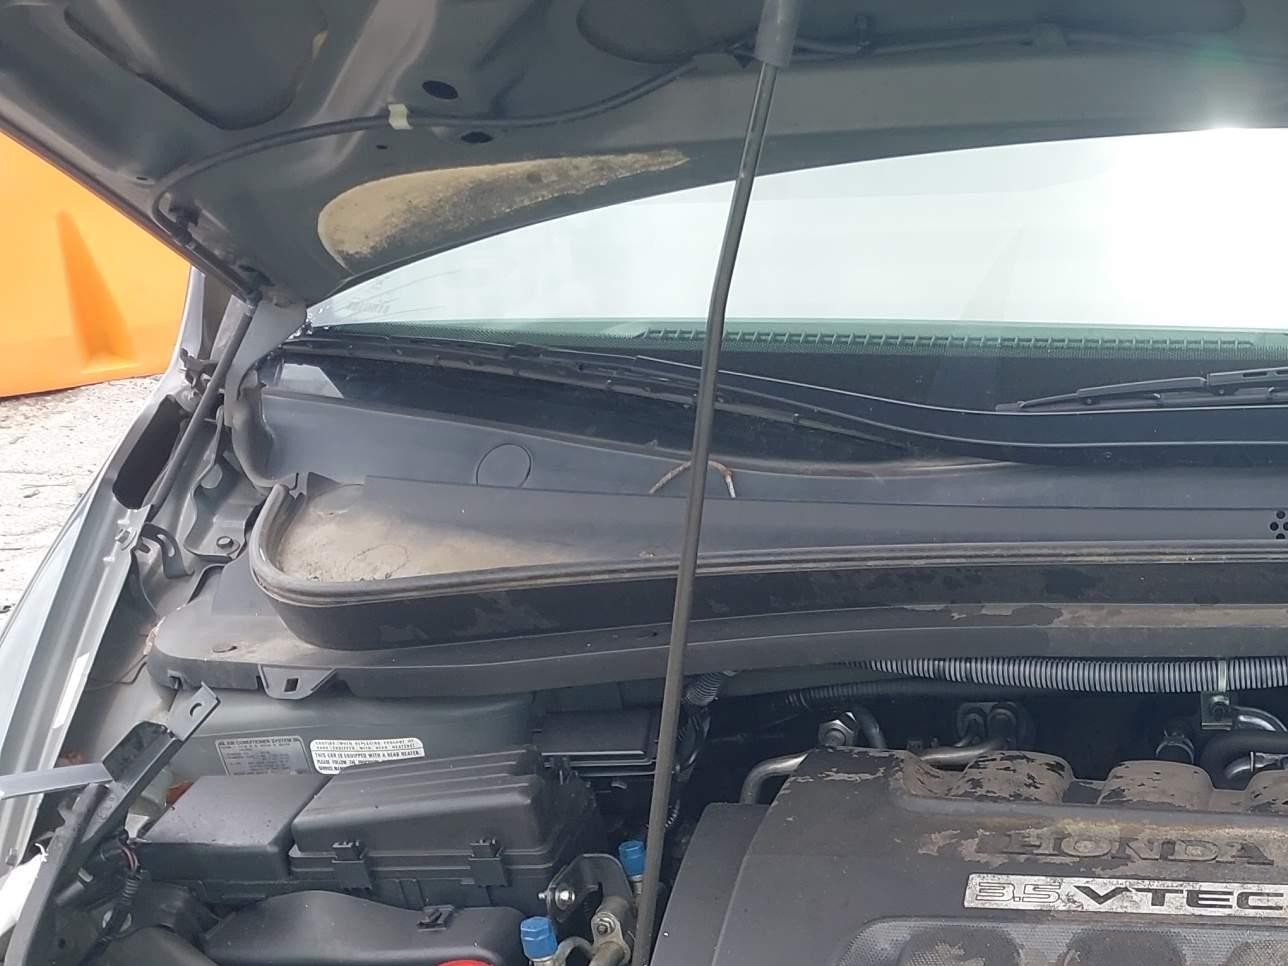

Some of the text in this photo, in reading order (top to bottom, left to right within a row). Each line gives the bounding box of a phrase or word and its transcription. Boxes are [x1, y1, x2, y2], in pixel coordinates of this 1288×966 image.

[1003, 832, 1275, 865] HONDA
[975, 881, 1285, 911] 3.5 VTEC
